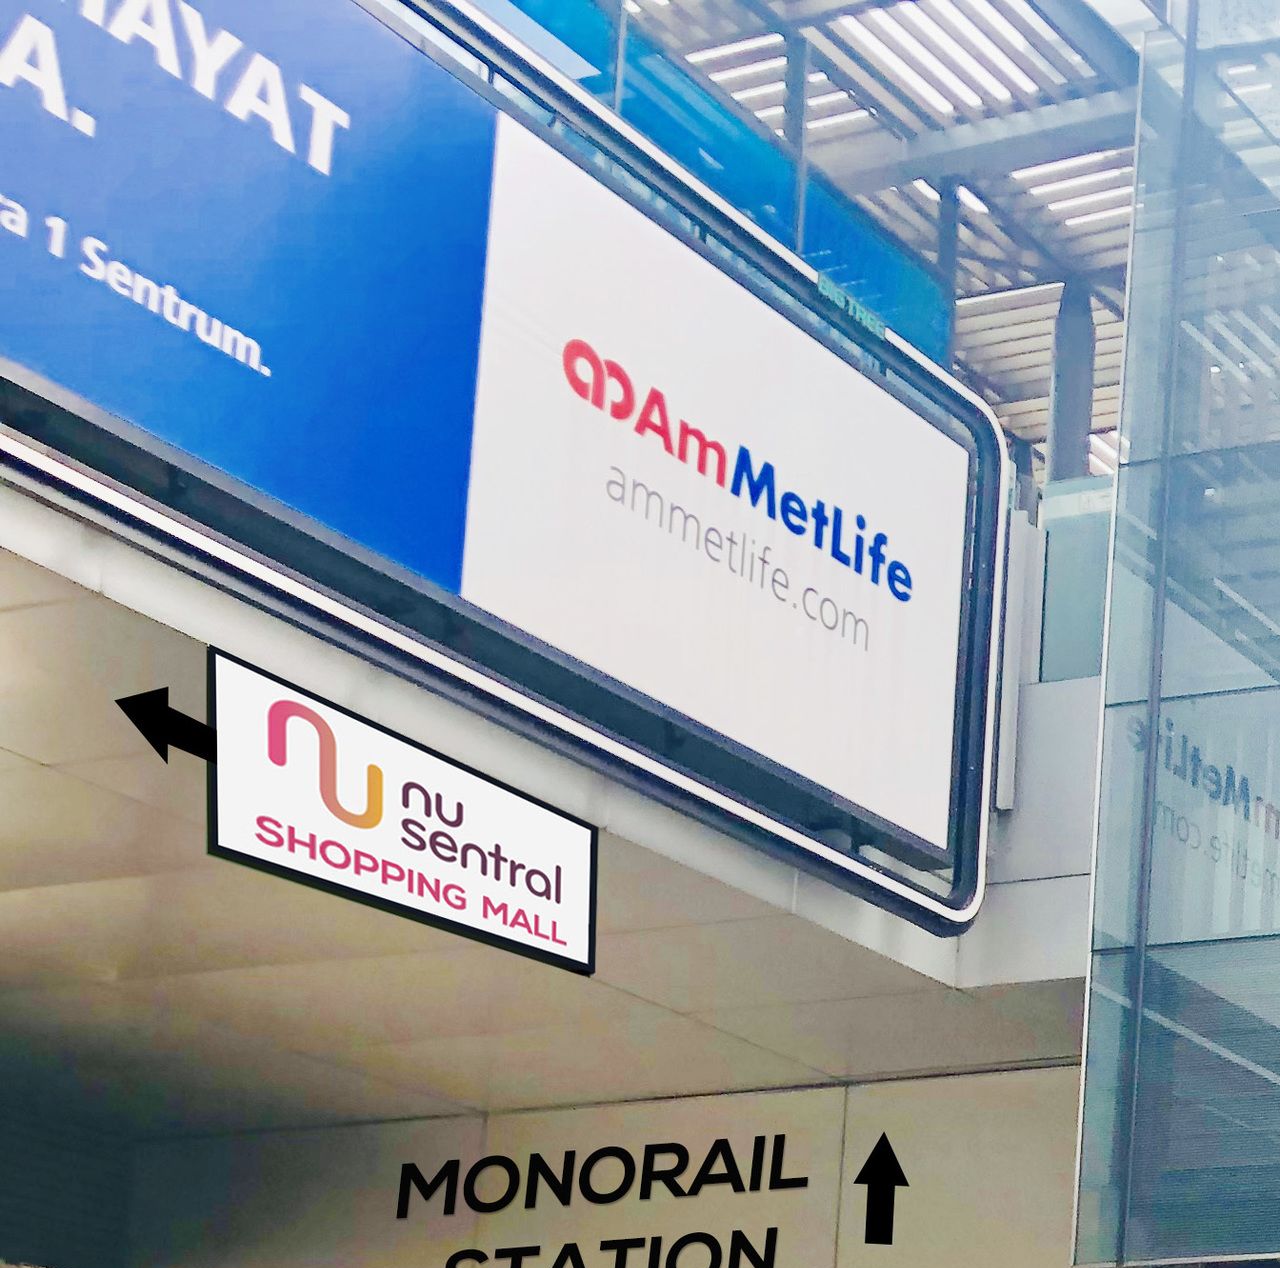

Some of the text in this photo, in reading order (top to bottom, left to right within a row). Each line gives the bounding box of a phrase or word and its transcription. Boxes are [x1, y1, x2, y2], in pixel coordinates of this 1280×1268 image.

[62, 0, 349, 176] AYAT
[45, 216, 67, 258] 1
[79, 236, 272, 377] Sentrum.
[606, 465, 871, 651] ammetlife.com
[634, 386, 913, 602] AmMetLife
[402, 782, 464, 828] nu
[402, 818, 562, 904] sentral
[255, 815, 567, 947] SHOPPING MALL
[396, 1133, 809, 1220] MONORAIL
